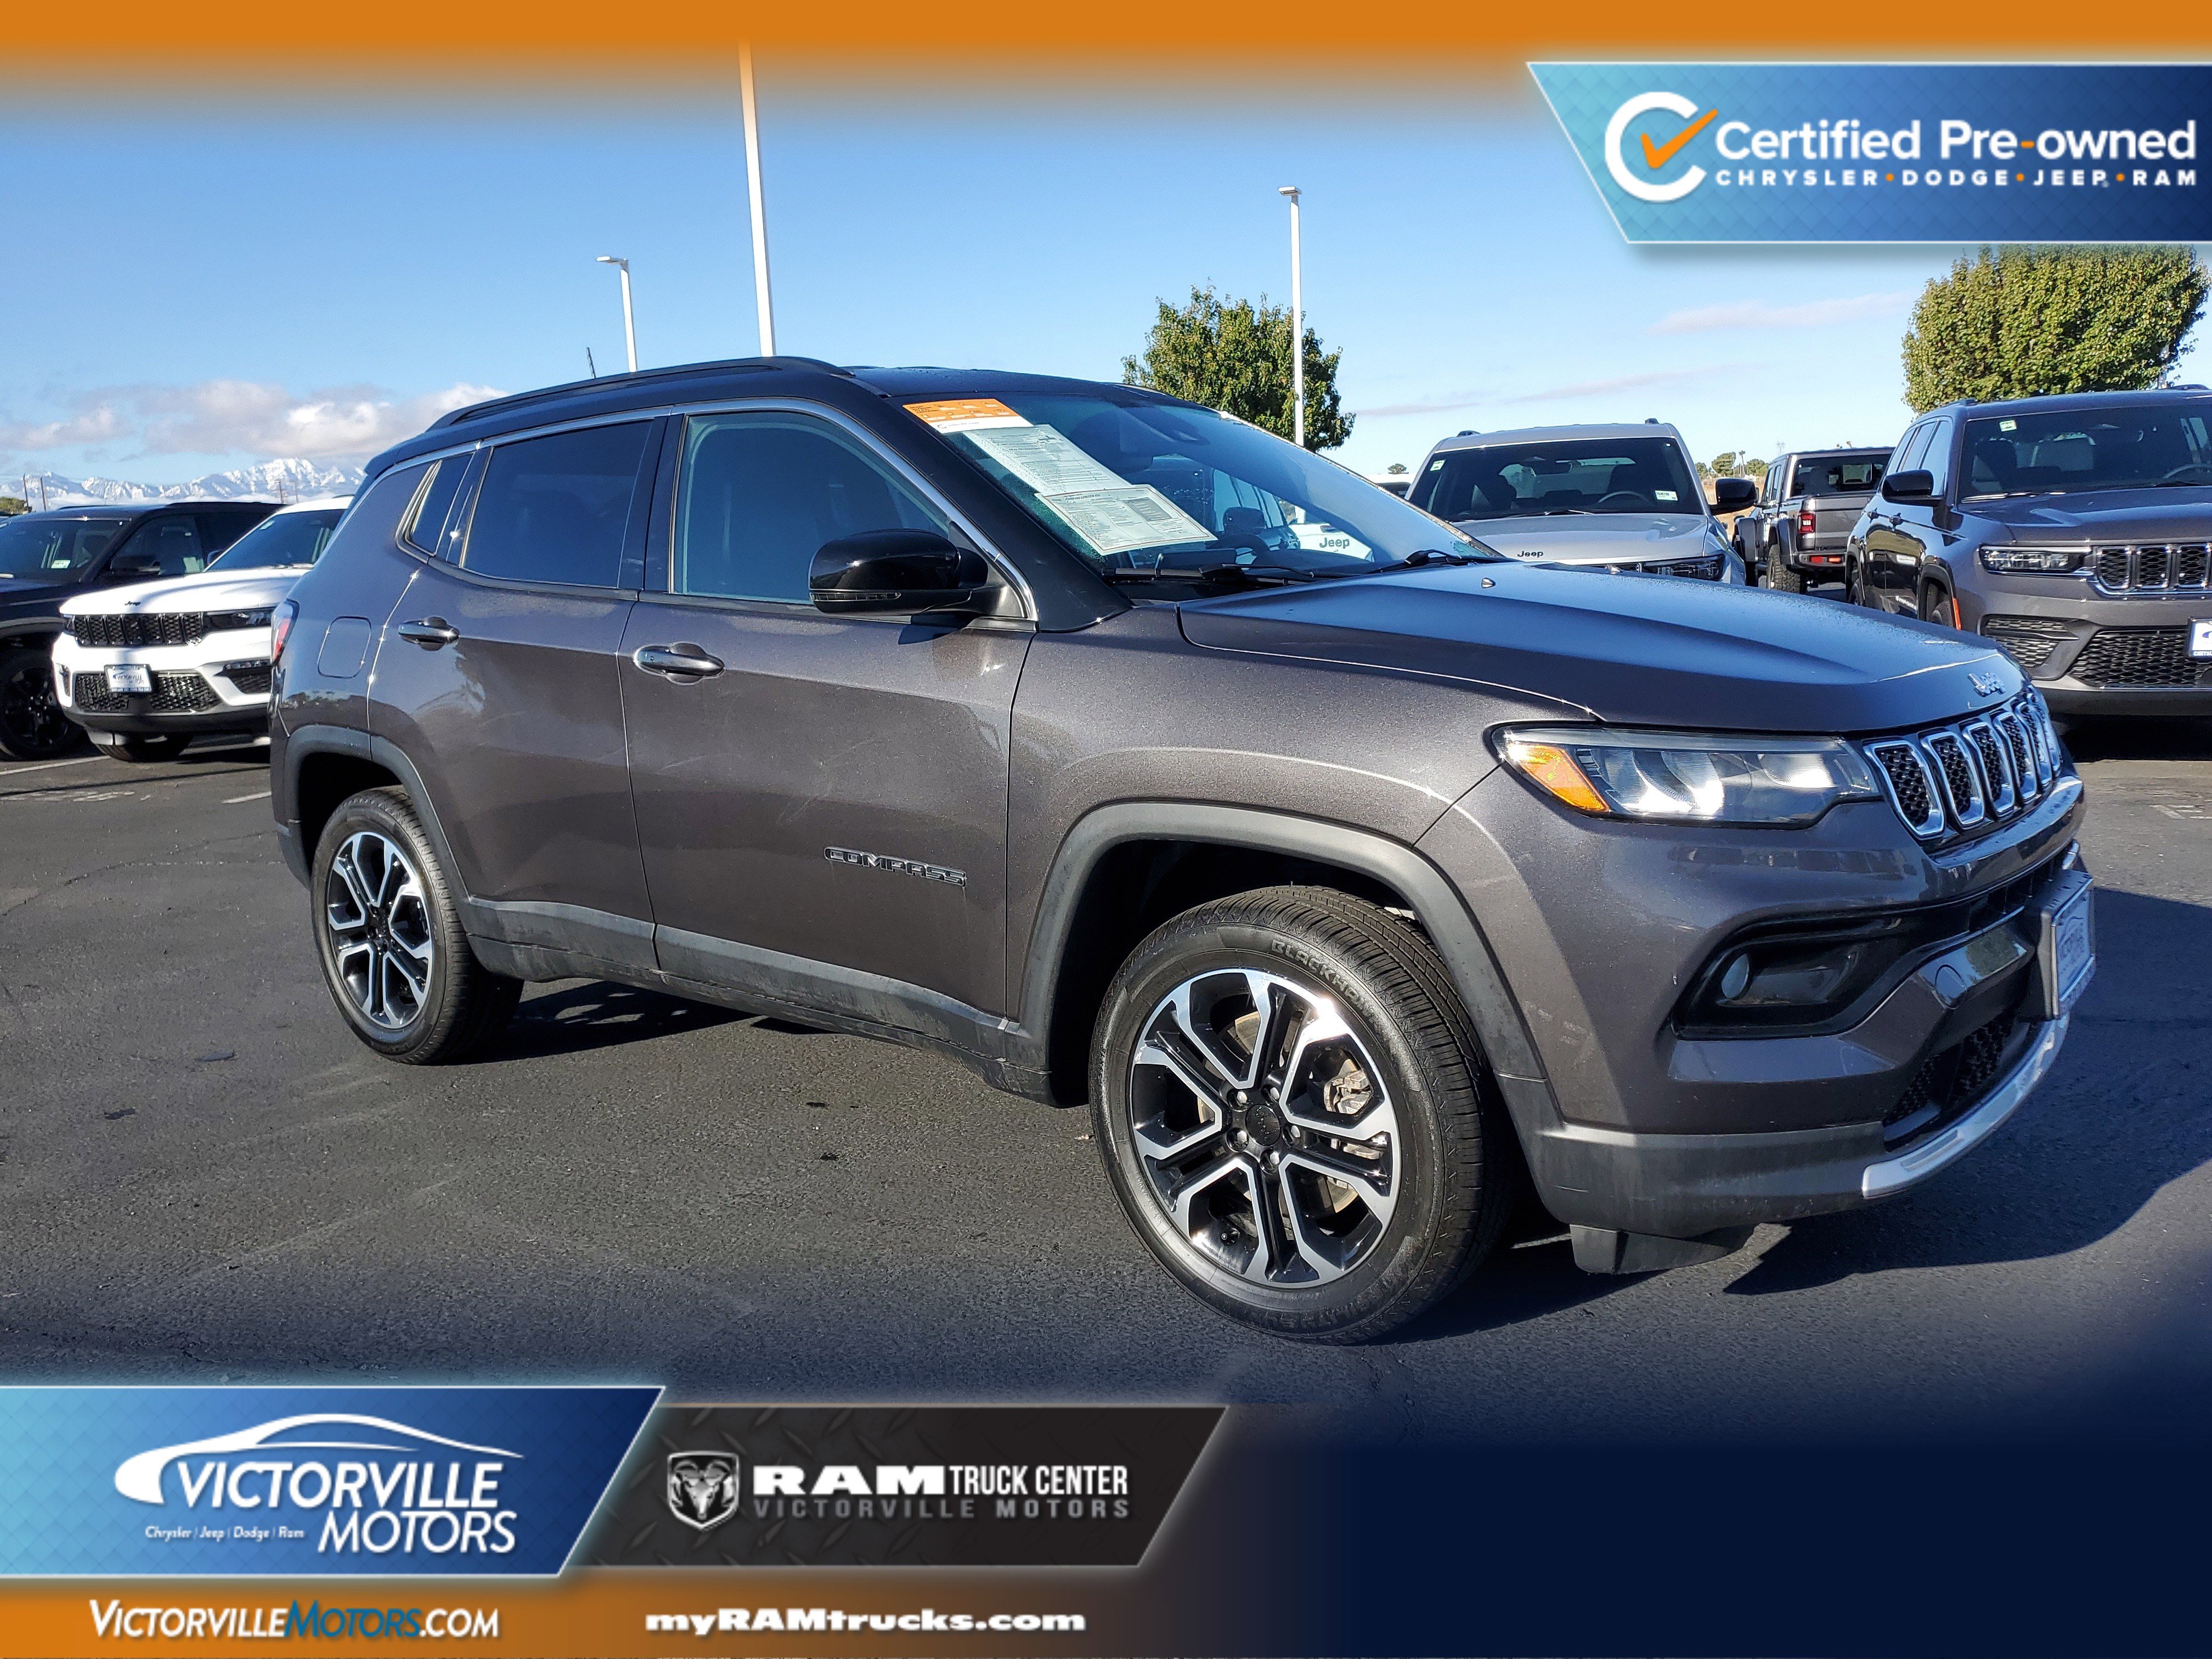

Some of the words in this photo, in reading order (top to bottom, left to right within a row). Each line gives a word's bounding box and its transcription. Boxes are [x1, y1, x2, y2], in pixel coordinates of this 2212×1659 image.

[1319, 538, 1350, 549] Jeep
[1517, 550, 1544, 558] Jeep
[824, 846, 966, 887] COMPASS
